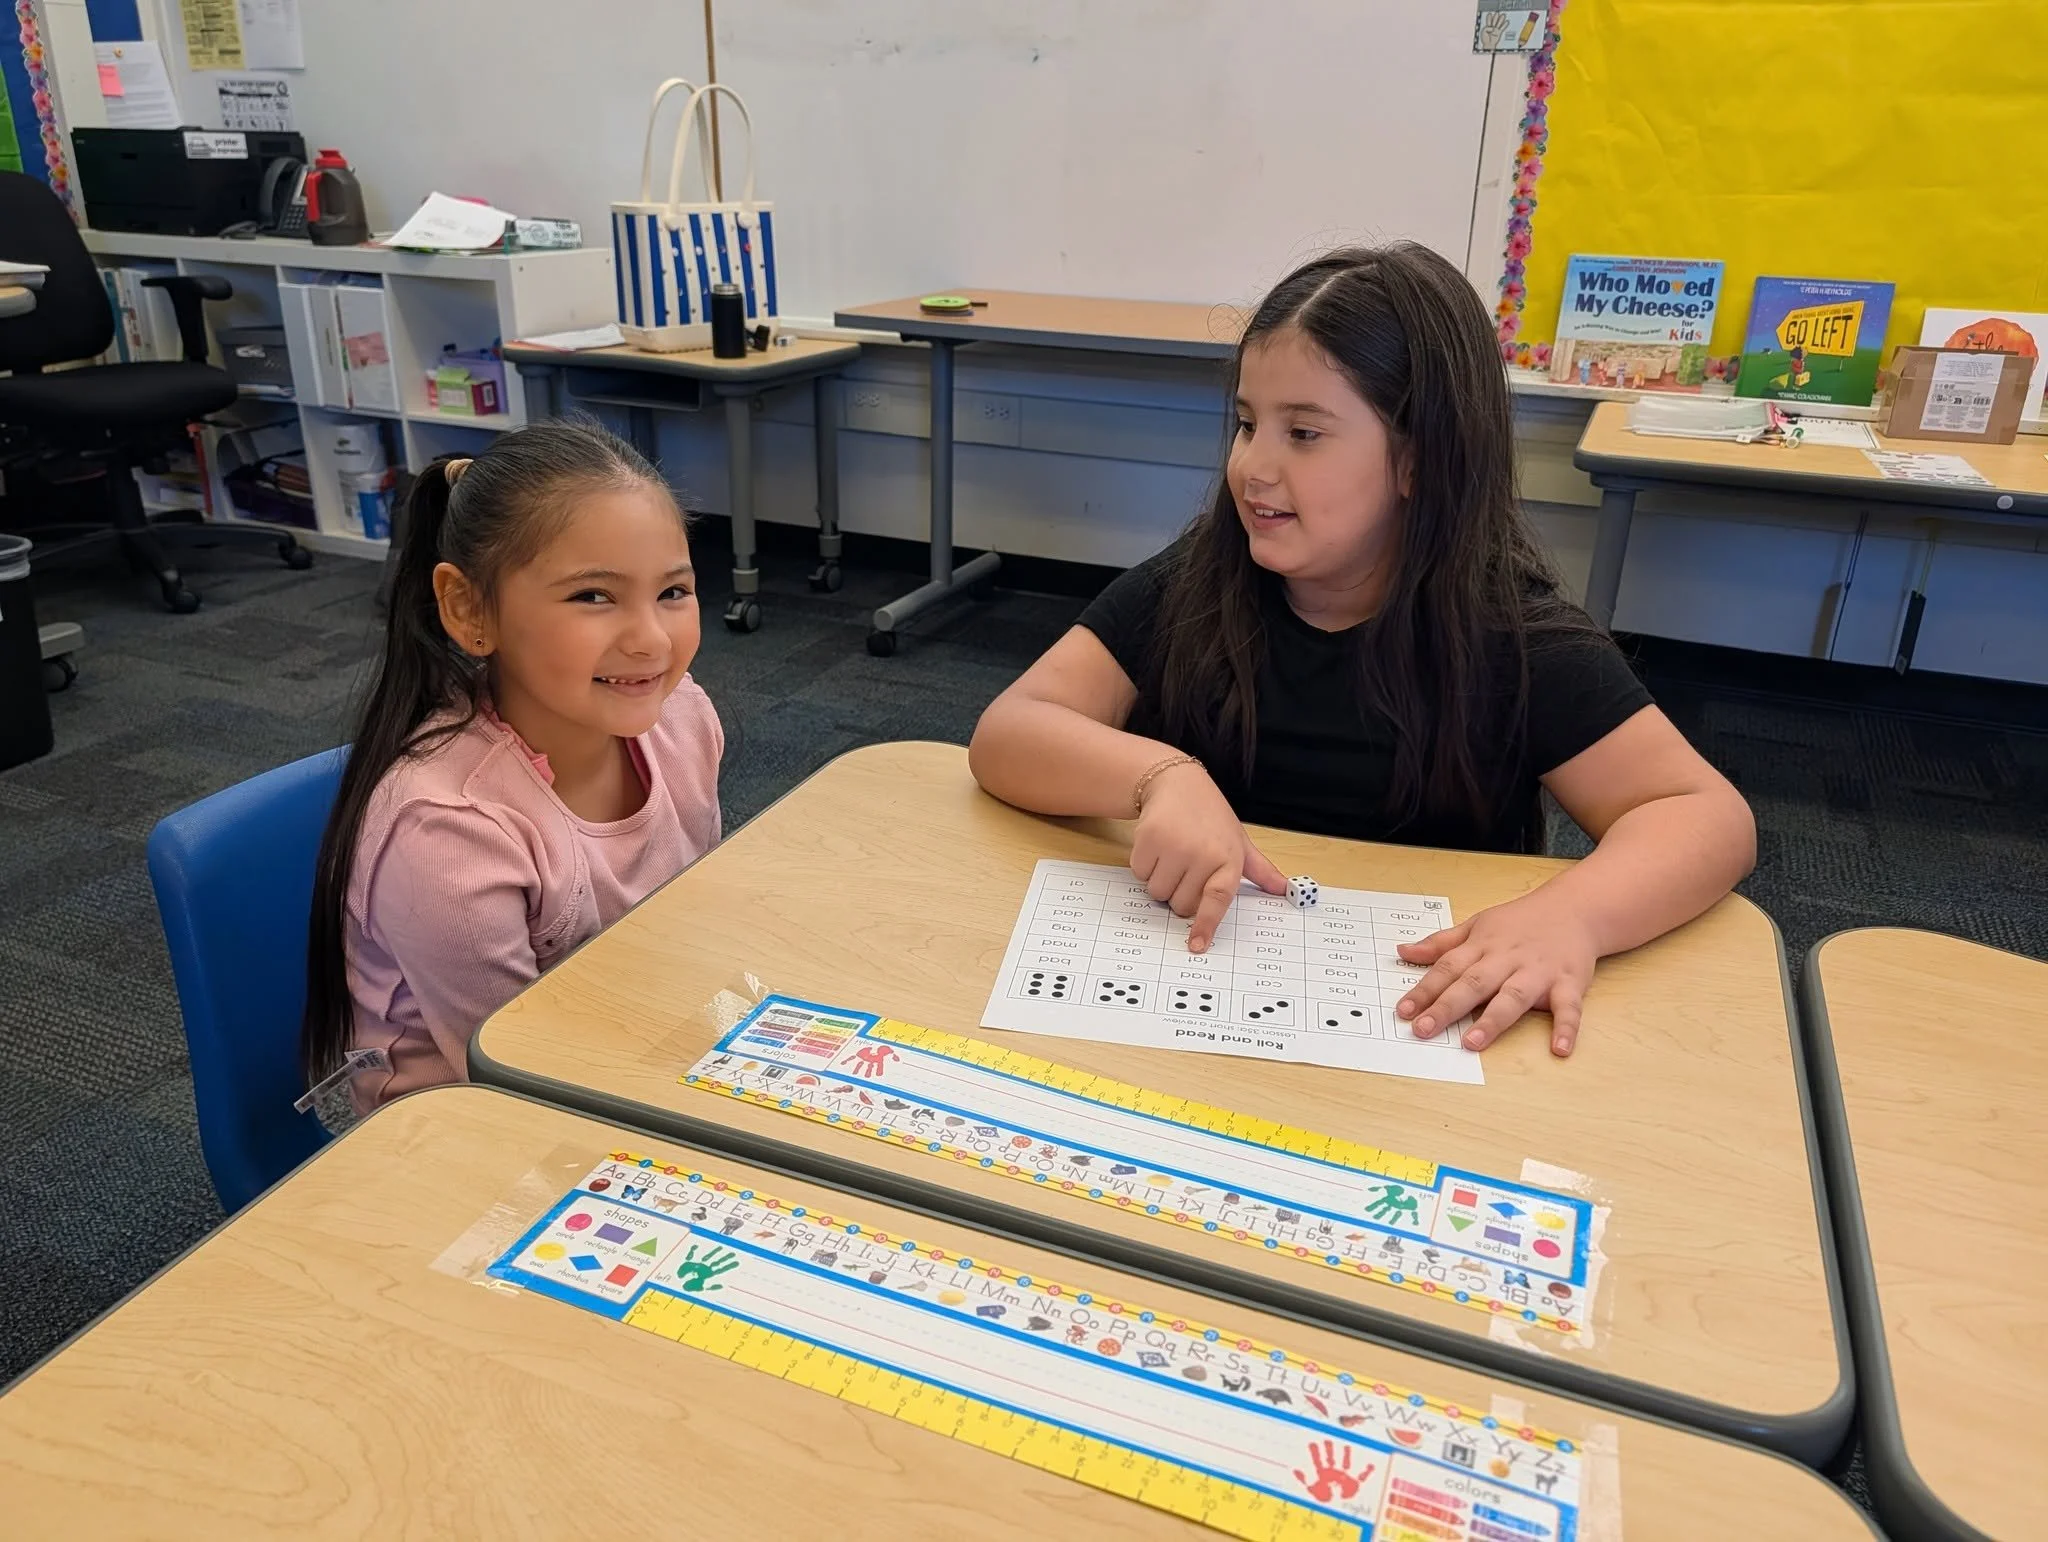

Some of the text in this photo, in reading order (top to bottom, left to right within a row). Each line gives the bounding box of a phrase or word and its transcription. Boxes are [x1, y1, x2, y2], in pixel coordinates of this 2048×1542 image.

[1579, 272, 1714, 297] Who Moved
[1575, 293, 1713, 319] My Cheese?
[1669, 328, 1702, 341] Kids
[1786, 315, 1853, 349] GO LEFT
[1070, 880, 1084, 888] at
[1061, 895, 1083, 903] vat
[1259, 900, 1283, 908] rap
[1124, 900, 1151, 910] yap
[1054, 909, 1083, 919] dad
[1325, 906, 1349, 916] tap
[1121, 915, 1148, 925] zap
[1257, 915, 1283, 924] sad
[1390, 912, 1419, 922] nab
[1052, 924, 1075, 934] tag
[1323, 921, 1354, 931] dab
[1114, 931, 1148, 941] map
[1256, 930, 1285, 940] mat
[1398, 929, 1416, 937] ax
[1042, 939, 1077, 949] mad
[1323, 937, 1356, 946] max
[1114, 946, 1141, 956] gas
[1256, 946, 1282, 956] fad
[1039, 955, 1071, 966] bad
[1188, 956, 1208, 965] fat
[1328, 953, 1352, 963] lap
[1117, 964, 1133, 972] as
[1257, 963, 1281, 972] lab
[1180, 971, 1211, 981] had
[1325, 968, 1357, 979] bag
[1256, 980, 1282, 989] cat
[1402, 977, 1420, 986] at
[1329, 986, 1356, 997] has
[1238, 1027, 1259, 1035] 35a:
[1263, 1030, 1296, 1039] Lesson
[1176, 1029, 1283, 1049] Roll and Read
[762, 1048, 796, 1061] colors
[701, 1063, 1574, 1316] Aa Bb Cc Dd Ee Ff Gg Hh Ii Jj Kk Ll Mm Nn Oo Pp Qq Rr Ss Tt Uu Vv Ww Xx Yy Zz
[603, 1207, 649, 1230] shapes
[556, 1230, 576, 1241] circle
[584, 1239, 618, 1255] rectangle
[1474, 1240, 1528, 1264] shapes
[623, 1251, 651, 1266] triangle
[530, 1260, 545, 1270] oval
[556, 1268, 589, 1285] rhombus
[655, 1273, 672, 1283] left
[597, 1283, 623, 1296] square
[599, 1164, 1566, 1475] Aa Bb Cc Dd Ee Ff Gg Hh Ii Jj Kk Ll Mm Nn Oo Pp Qq Rr Ss Tt Uu Vv Ww Xx Yy Zz
[1444, 1476, 1500, 1505] colors
